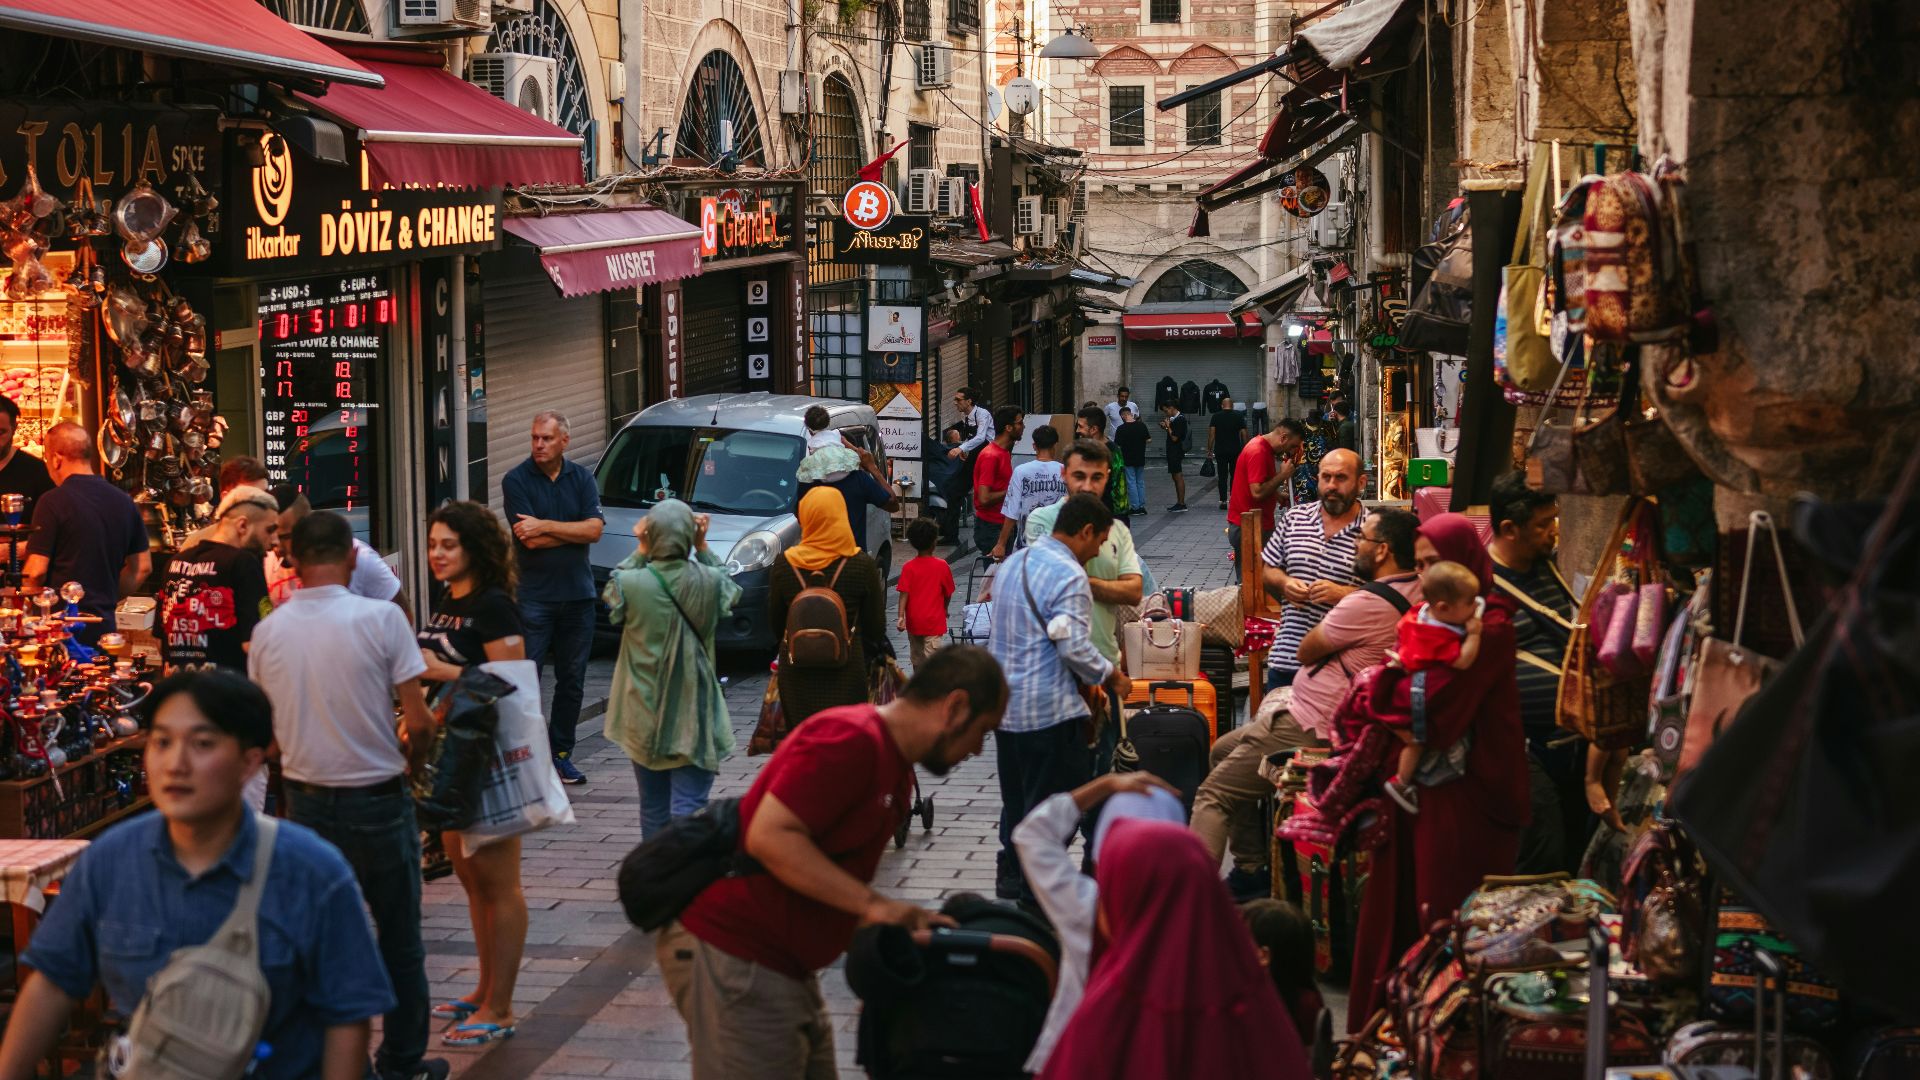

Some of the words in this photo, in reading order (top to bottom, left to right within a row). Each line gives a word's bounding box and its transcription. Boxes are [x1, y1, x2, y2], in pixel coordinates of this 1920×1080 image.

[320, 198, 393, 257] DÖVİZ
[398, 215, 414, 251] &
[417, 204, 496, 249] CHANGE
[703, 203, 715, 250] G
[722, 199, 778, 250] GrandEx
[246, 225, 300, 260] ilkarlar
[605, 249, 657, 282] NUSRET
[330, 337, 338, 348] &
[339, 336, 380, 348] CHANGE
[1165, 328, 1180, 337] HS
[1181, 327, 1222, 337] Concept
[434, 276, 451, 504] CHAN
[265, 411, 286, 421] GBP
[265, 425, 286, 436] CHF
[266, 440, 286, 451] DKK
[266, 455, 285, 466] SEK
[168, 560, 218, 577] NATIONAL
[188, 597, 226, 628] BALL
